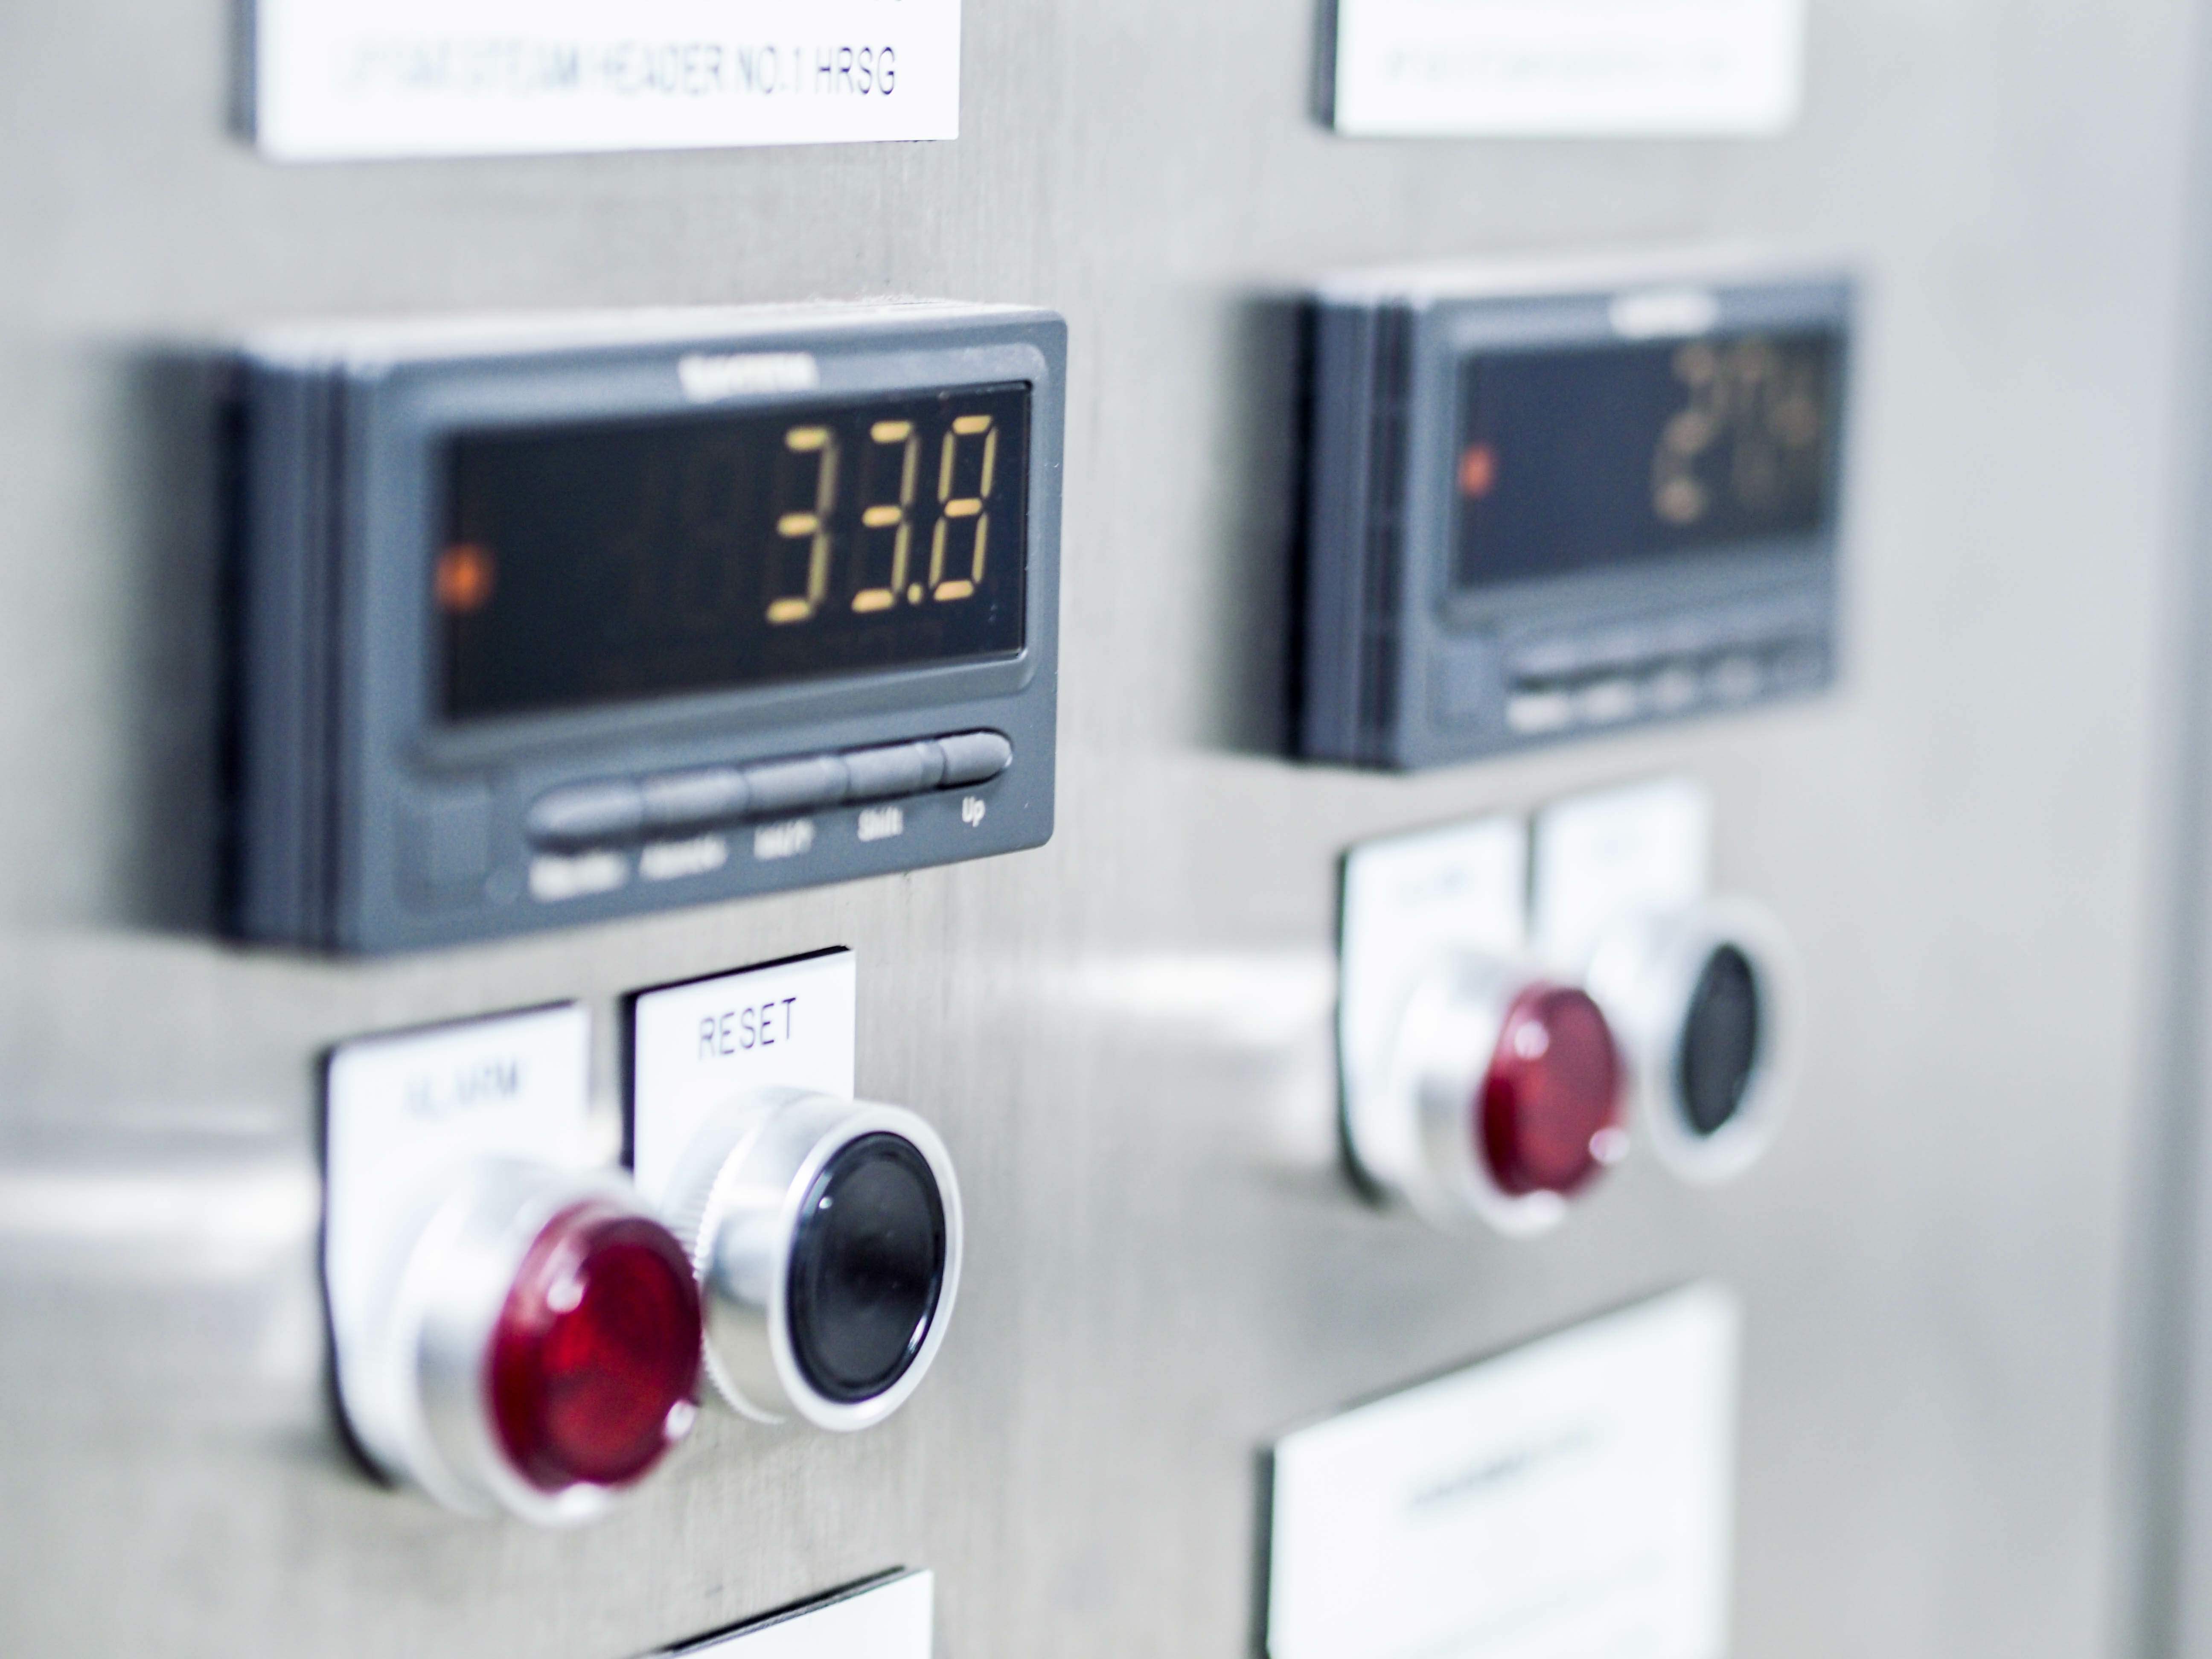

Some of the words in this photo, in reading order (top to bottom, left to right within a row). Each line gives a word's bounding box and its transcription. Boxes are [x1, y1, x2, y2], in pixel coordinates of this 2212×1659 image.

[815, 46, 895, 95] HRSG
[766, 414, 998, 625] 33.8
[961, 795, 986, 828] Up
[698, 996, 797, 1062] RESET
